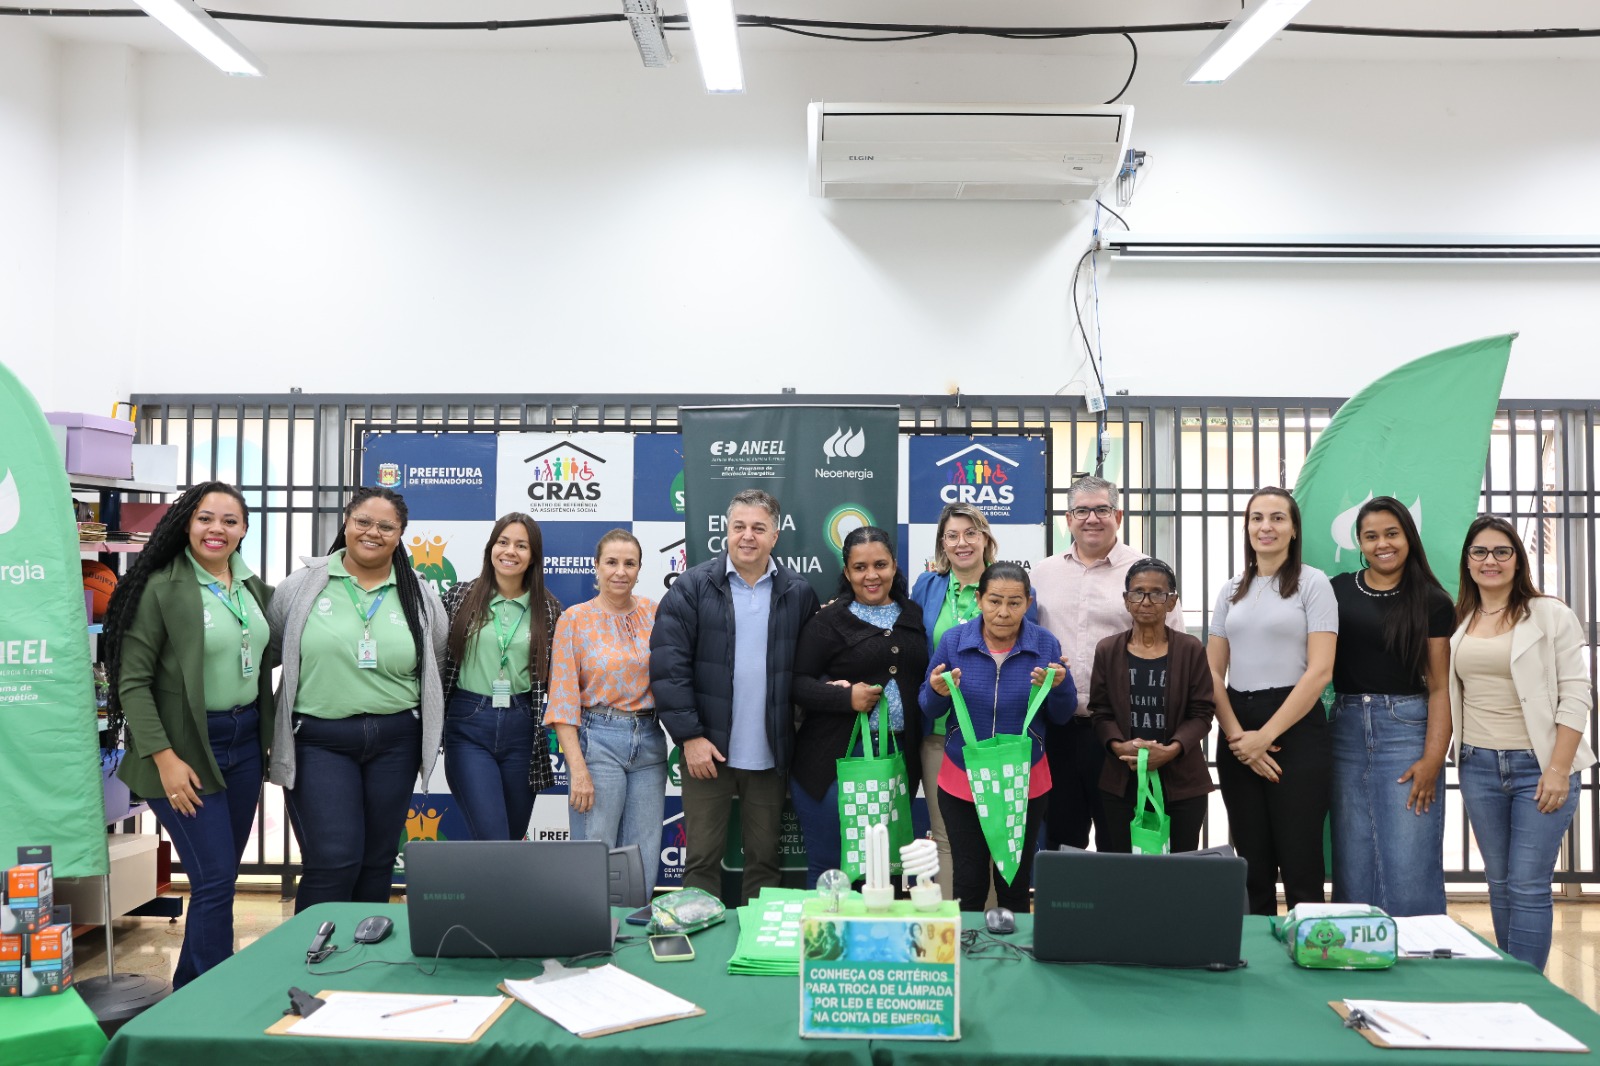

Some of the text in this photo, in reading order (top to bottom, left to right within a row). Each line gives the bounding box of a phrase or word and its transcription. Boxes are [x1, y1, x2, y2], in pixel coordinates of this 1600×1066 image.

[739, 440, 786, 455] ANEEL
[409, 467, 483, 477] PREFEITURA
[815, 468, 874, 480] Neoenergia
[420, 477, 483, 485] FERNANDÓPOLIS
[527, 482, 601, 501] CRAS
[940, 484, 1015, 504] CRAS
[540, 831, 570, 841] PREF
[810, 968, 948, 982] CONHEÇA OS CRITÉRIOS
[805, 982, 953, 997] PARA TROCA DE LÂMPADA
[814, 997, 944, 1011] POR LED E ECONOMIZE
[813, 1011, 829, 1023] NA
[831, 1011, 871, 1023] CONTA
[872, 1012, 888, 1023] DE
